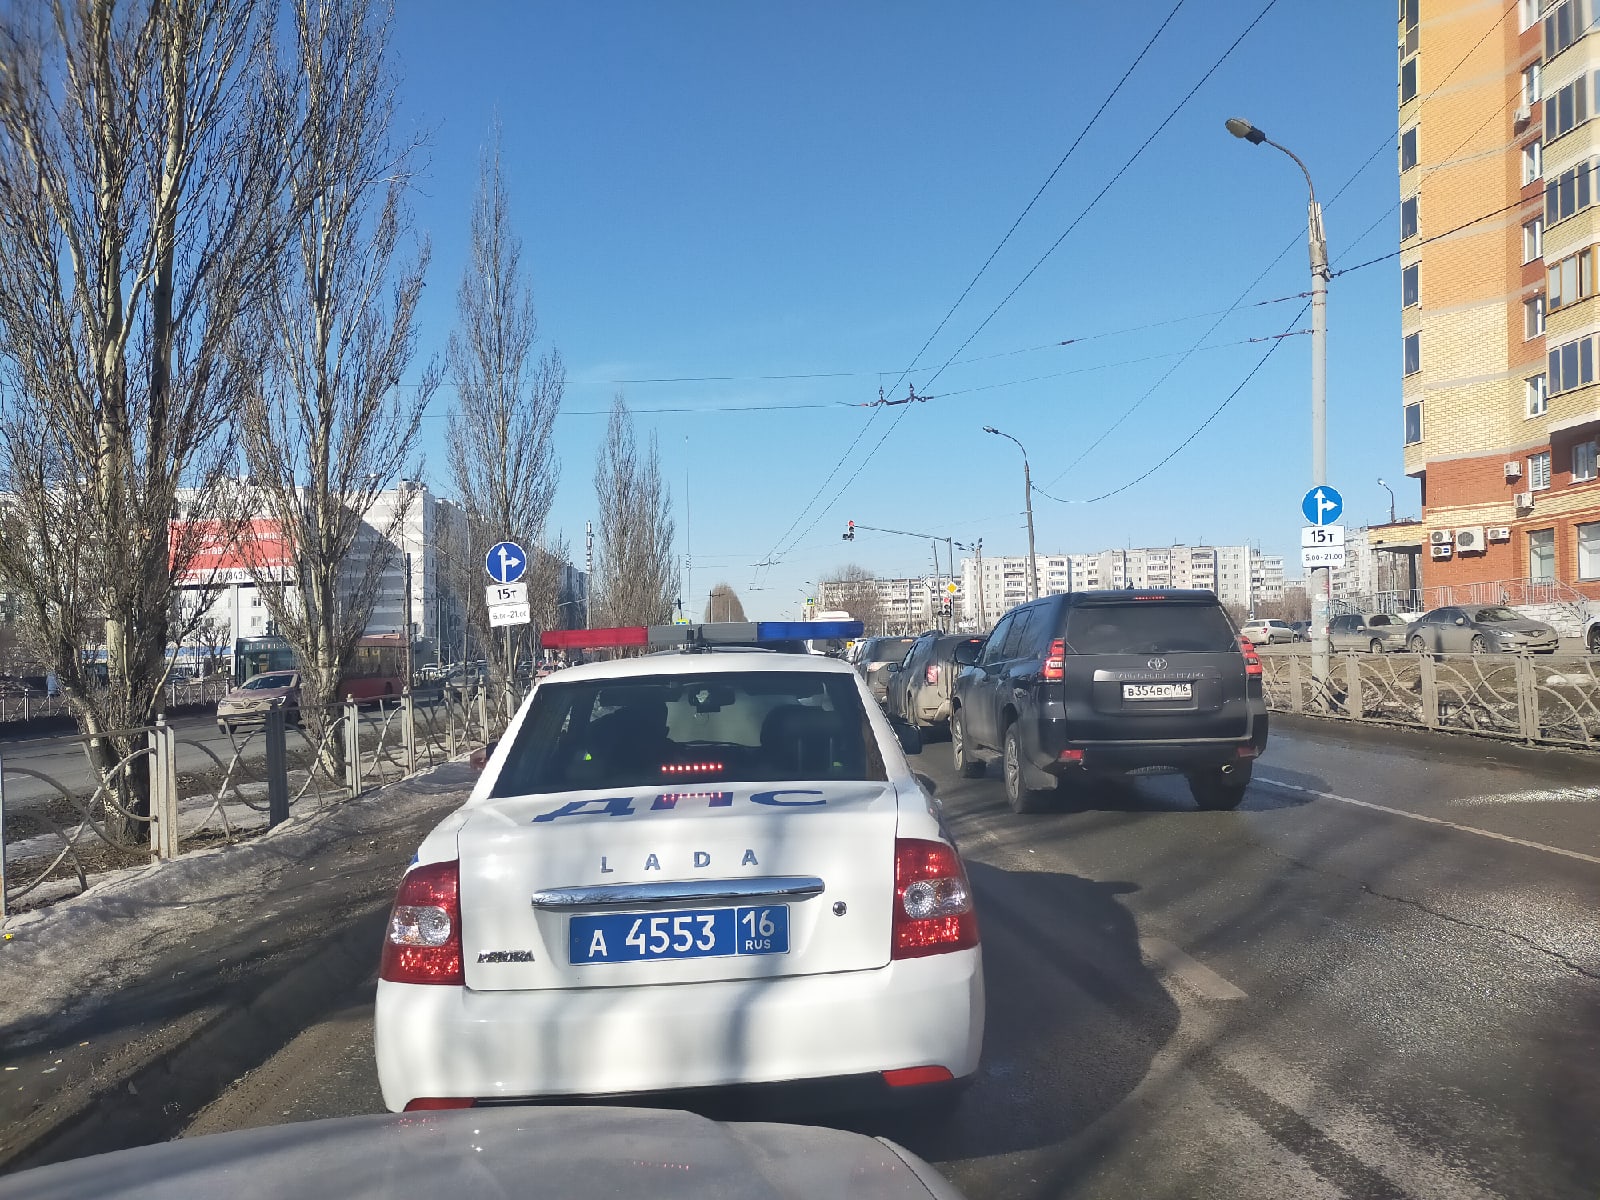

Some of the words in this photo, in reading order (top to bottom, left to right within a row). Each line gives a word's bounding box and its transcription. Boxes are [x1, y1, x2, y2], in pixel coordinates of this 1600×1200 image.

[532, 789, 827, 823] ДПС
[600, 849, 759, 873] LADA
[625, 915, 716, 955] 4553
[742, 909, 775, 938] 16
[745, 939, 771, 951] RUS
